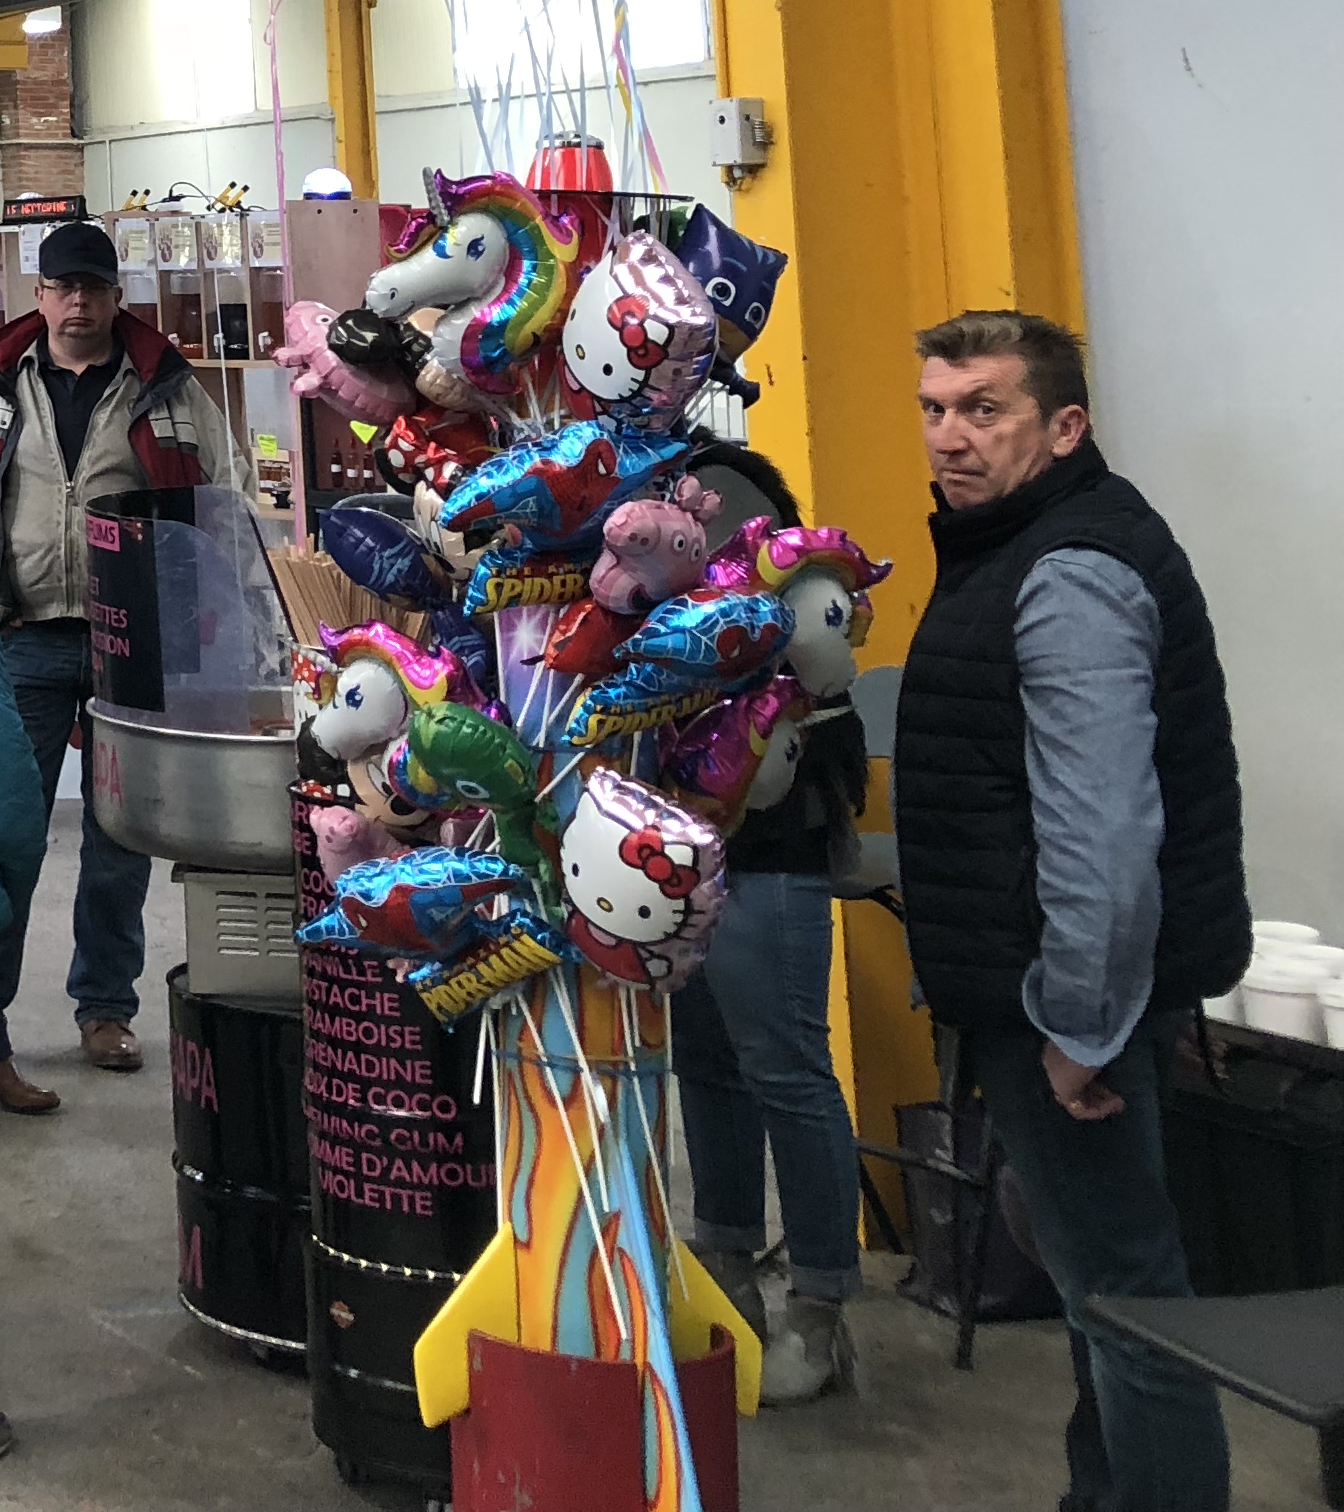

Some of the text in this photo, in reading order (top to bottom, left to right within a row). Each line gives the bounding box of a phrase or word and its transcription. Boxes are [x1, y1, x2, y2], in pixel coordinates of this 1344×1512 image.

[490, 566, 532, 577] THE
[475, 572, 585, 614] SPIDER
[331, 1078, 362, 1108] DE
[367, 1087, 458, 1121] COCO
[390, 1128, 465, 1155] GUM
